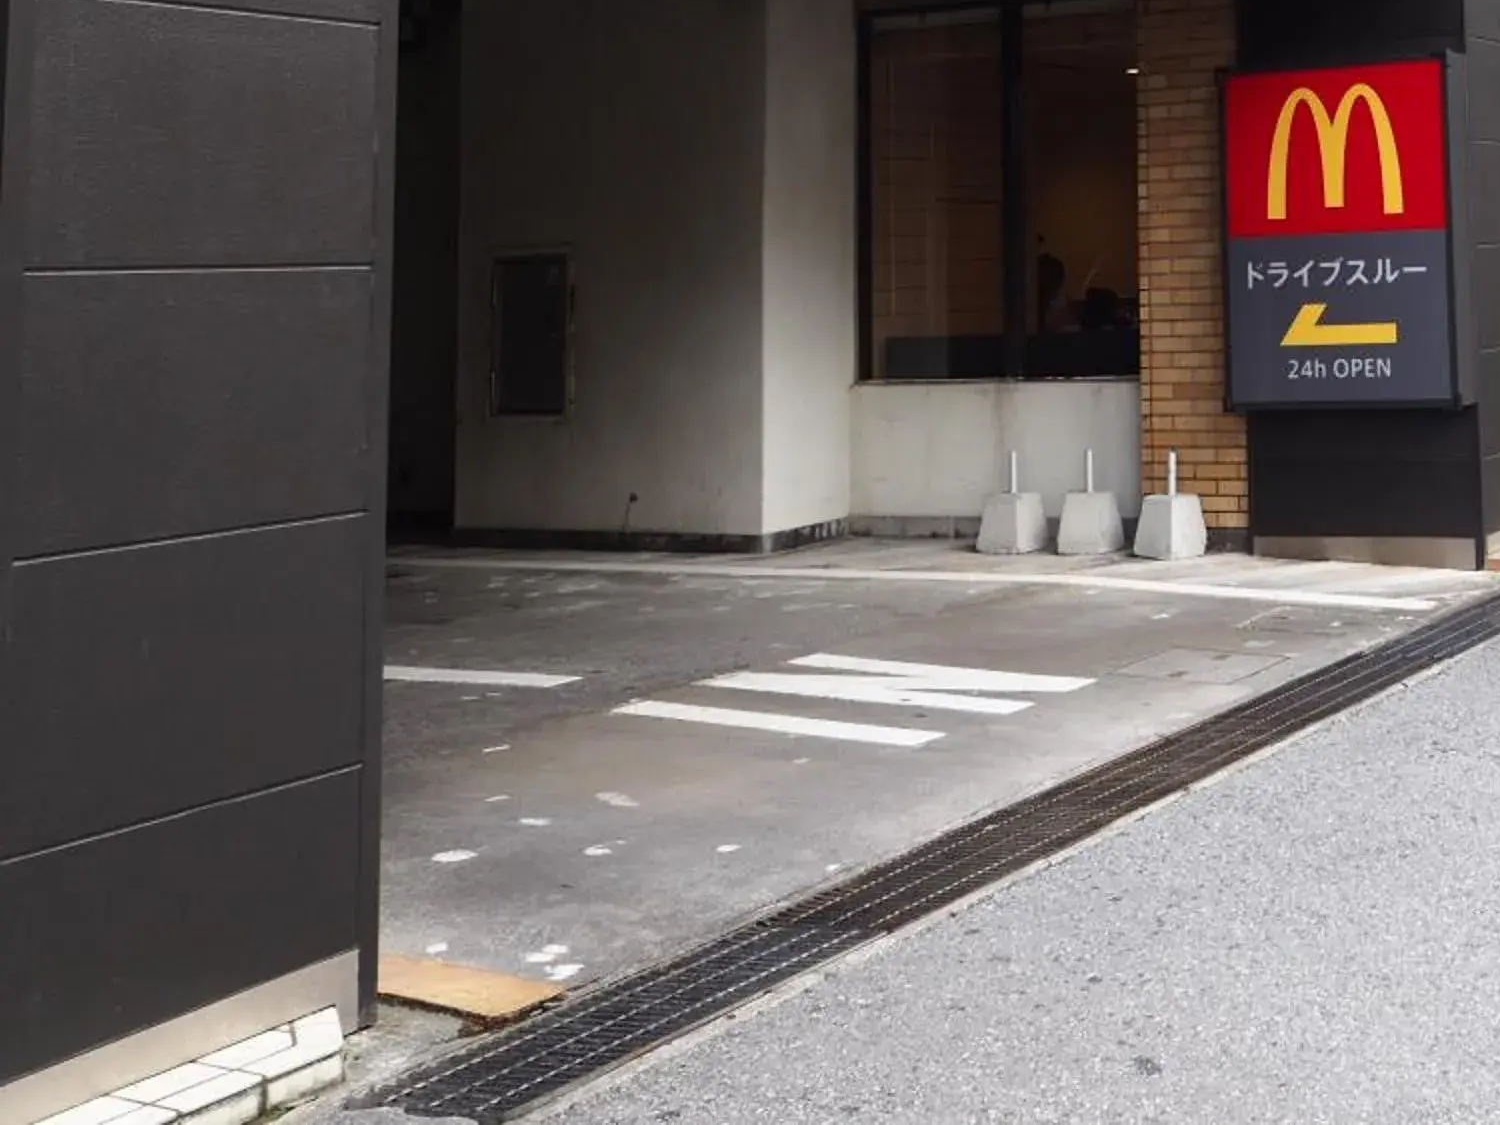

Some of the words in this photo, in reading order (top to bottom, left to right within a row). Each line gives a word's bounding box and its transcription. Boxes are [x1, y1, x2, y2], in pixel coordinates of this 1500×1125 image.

[1246, 257, 1428, 289] ドライブスルー
[1287, 358, 1327, 379] 24h
[1333, 358, 1392, 379] OPEN
